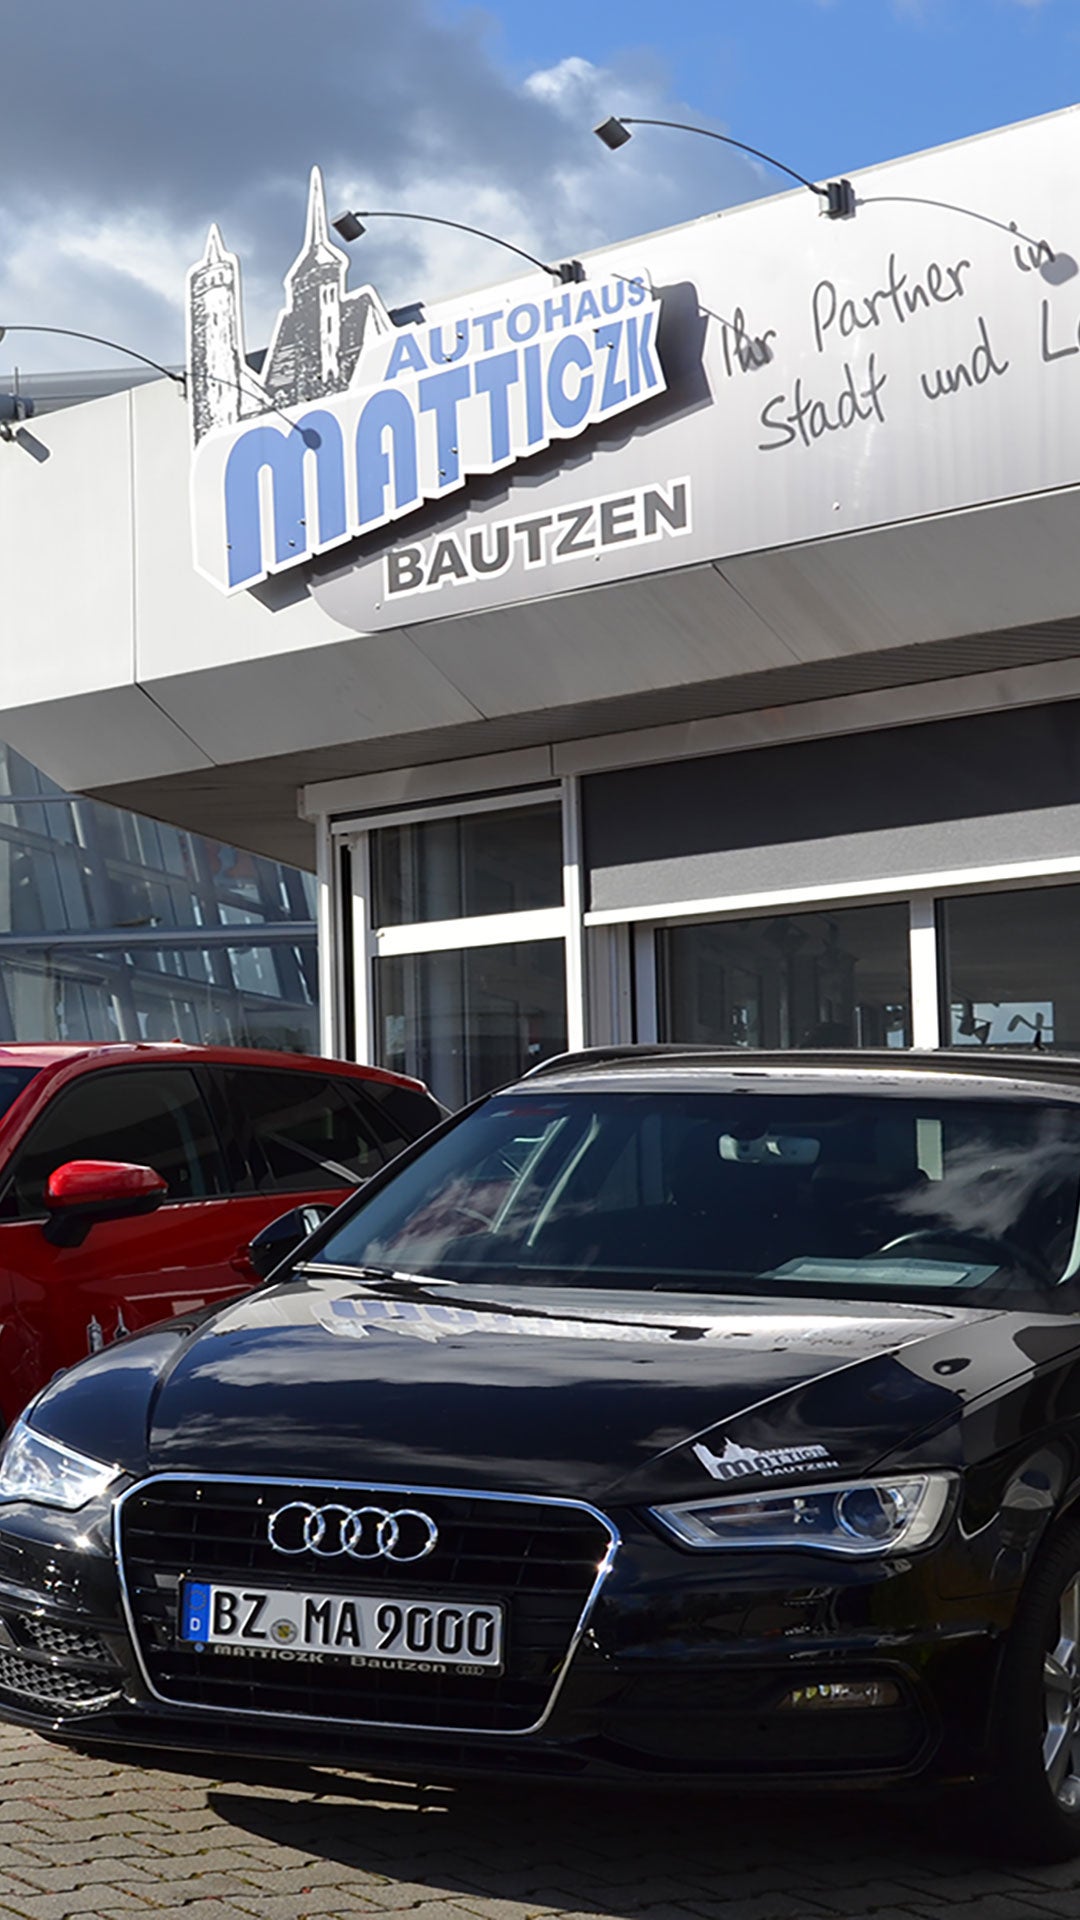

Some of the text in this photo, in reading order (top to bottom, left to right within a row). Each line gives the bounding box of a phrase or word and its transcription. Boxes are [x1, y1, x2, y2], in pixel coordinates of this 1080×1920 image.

[384, 275, 645, 381] AUTOHAUS
[721, 221, 1056, 377] Ihr Partner in
[758, 299, 1080, 449] Stadt und L
[224, 311, 658, 589] MATTICZK
[387, 482, 688, 594] BAUTZEN
[212, 1590, 495, 1658] BZ MA 9000
[350, 1655, 447, 1674] Bautzen
